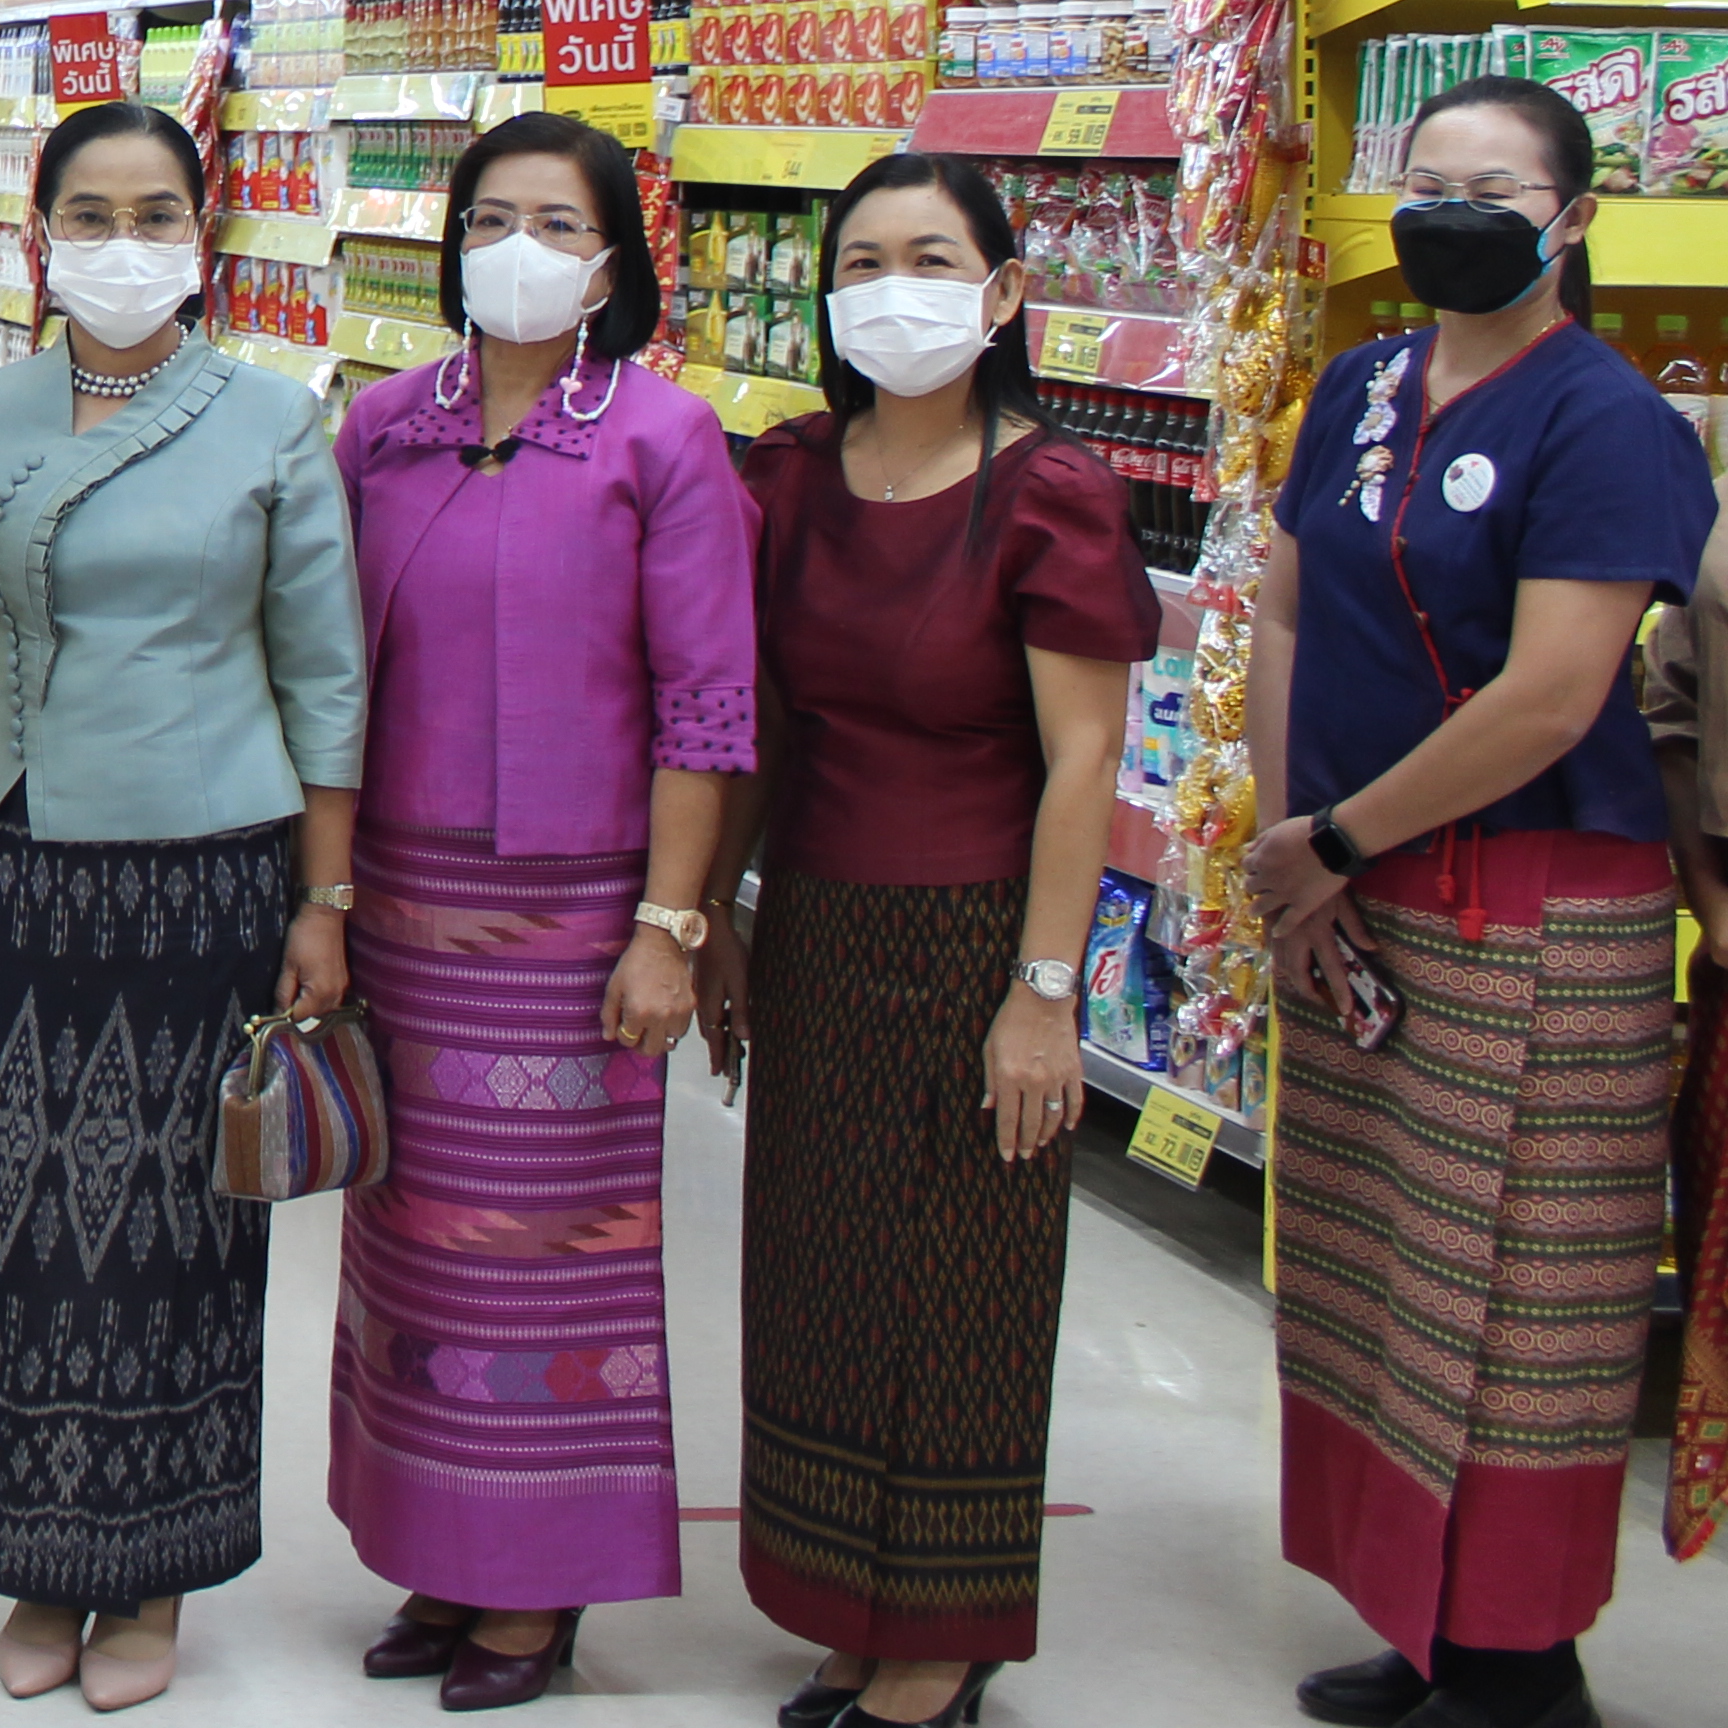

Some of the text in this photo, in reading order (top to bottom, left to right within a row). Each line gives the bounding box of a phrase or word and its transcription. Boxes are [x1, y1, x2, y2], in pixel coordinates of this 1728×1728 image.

[52, 38, 116, 64] พิเศษ
[557, 22, 638, 75] วันนี้
[62, 61, 112, 96] วันนี้
